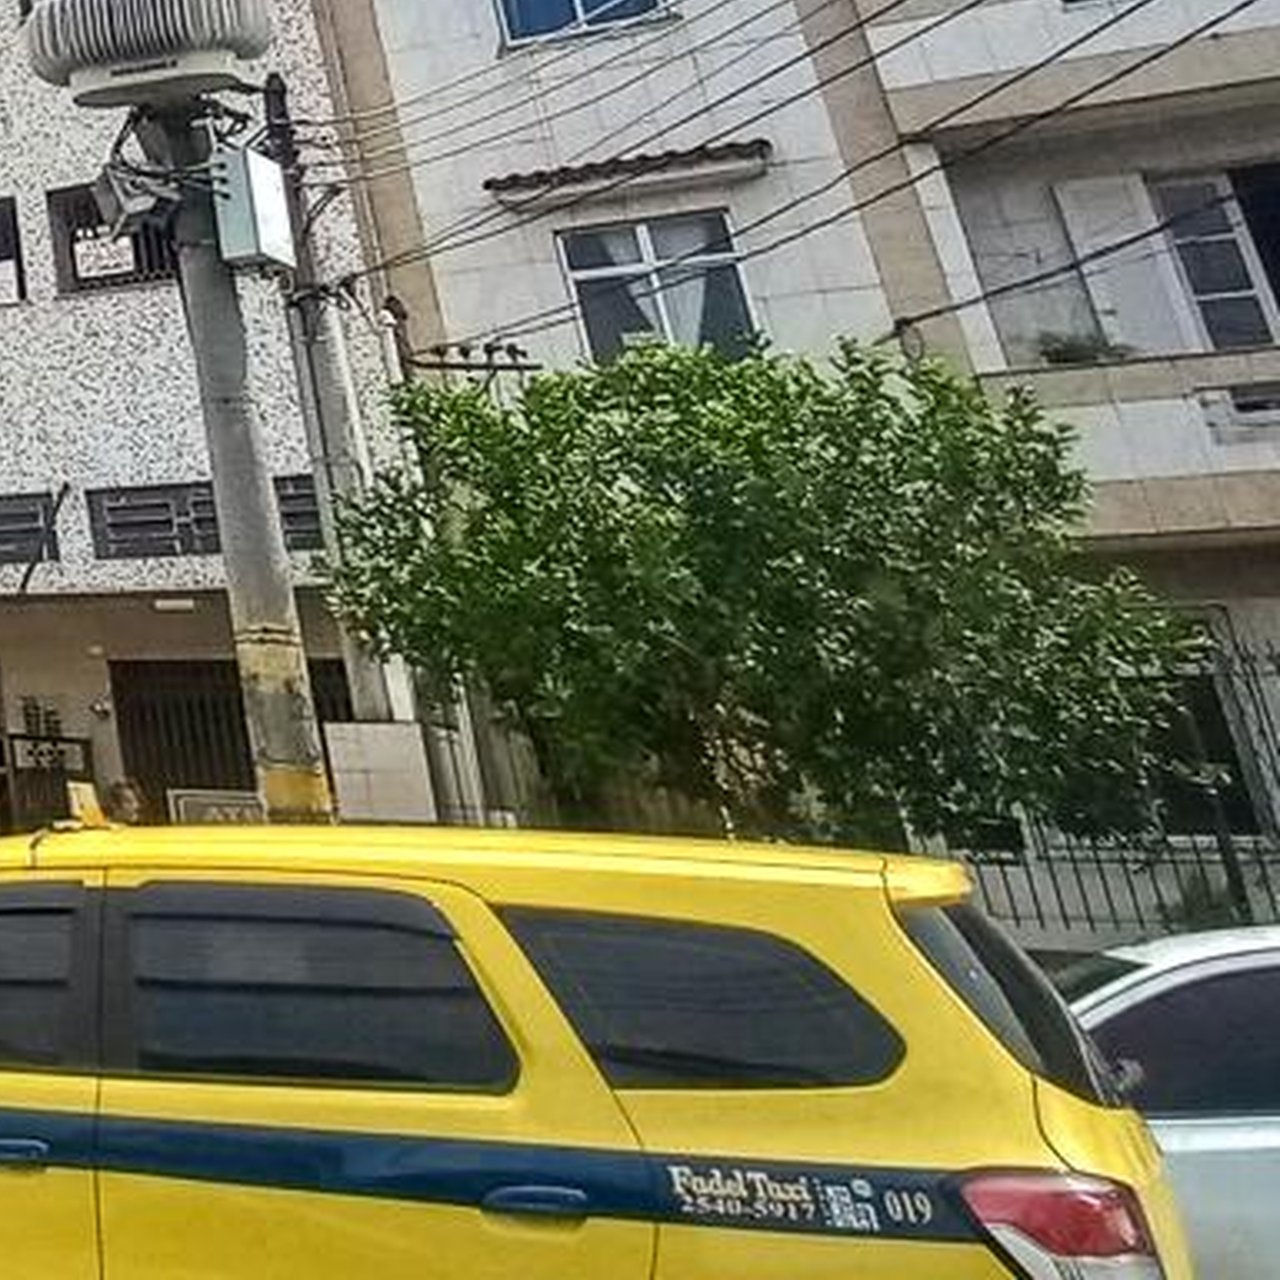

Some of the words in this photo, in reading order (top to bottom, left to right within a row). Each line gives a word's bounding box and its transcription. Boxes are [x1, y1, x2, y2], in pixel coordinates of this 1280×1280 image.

[668, 1166, 748, 1197] Fadel
[747, 1173, 812, 1202] Taxi
[883, 1190, 933, 1224] 019
